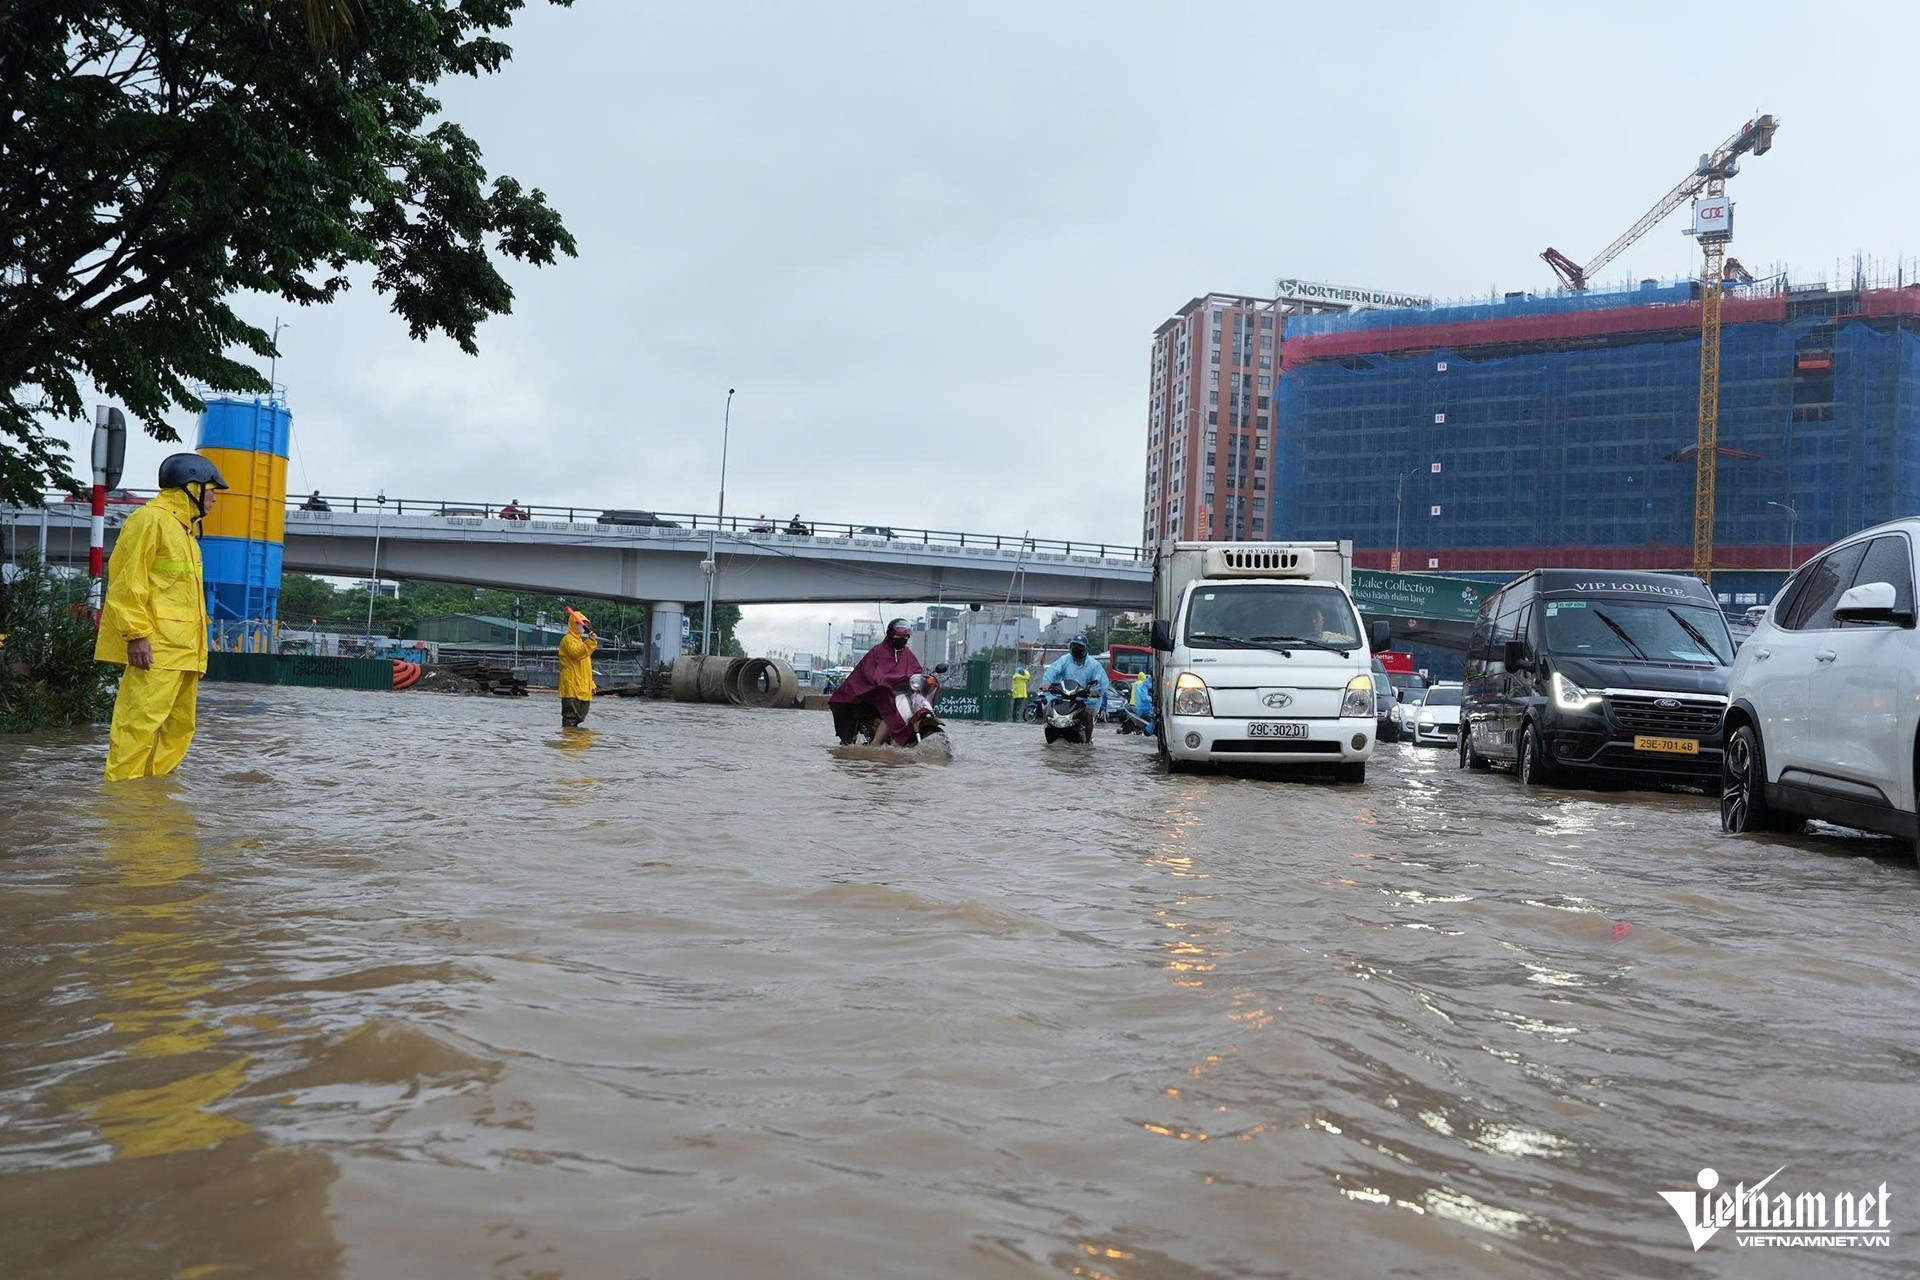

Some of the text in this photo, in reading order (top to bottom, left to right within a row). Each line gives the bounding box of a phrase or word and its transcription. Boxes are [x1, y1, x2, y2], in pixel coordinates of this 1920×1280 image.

[1298, 284, 1432, 309] NORTHERN DIAMOND
[1358, 576, 1383, 589] Lake
[1384, 579, 1435, 594] Collection
[1575, 582, 1686, 597] VIP LOUNGE
[1640, 739, 1693, 751] 29E-701.48
